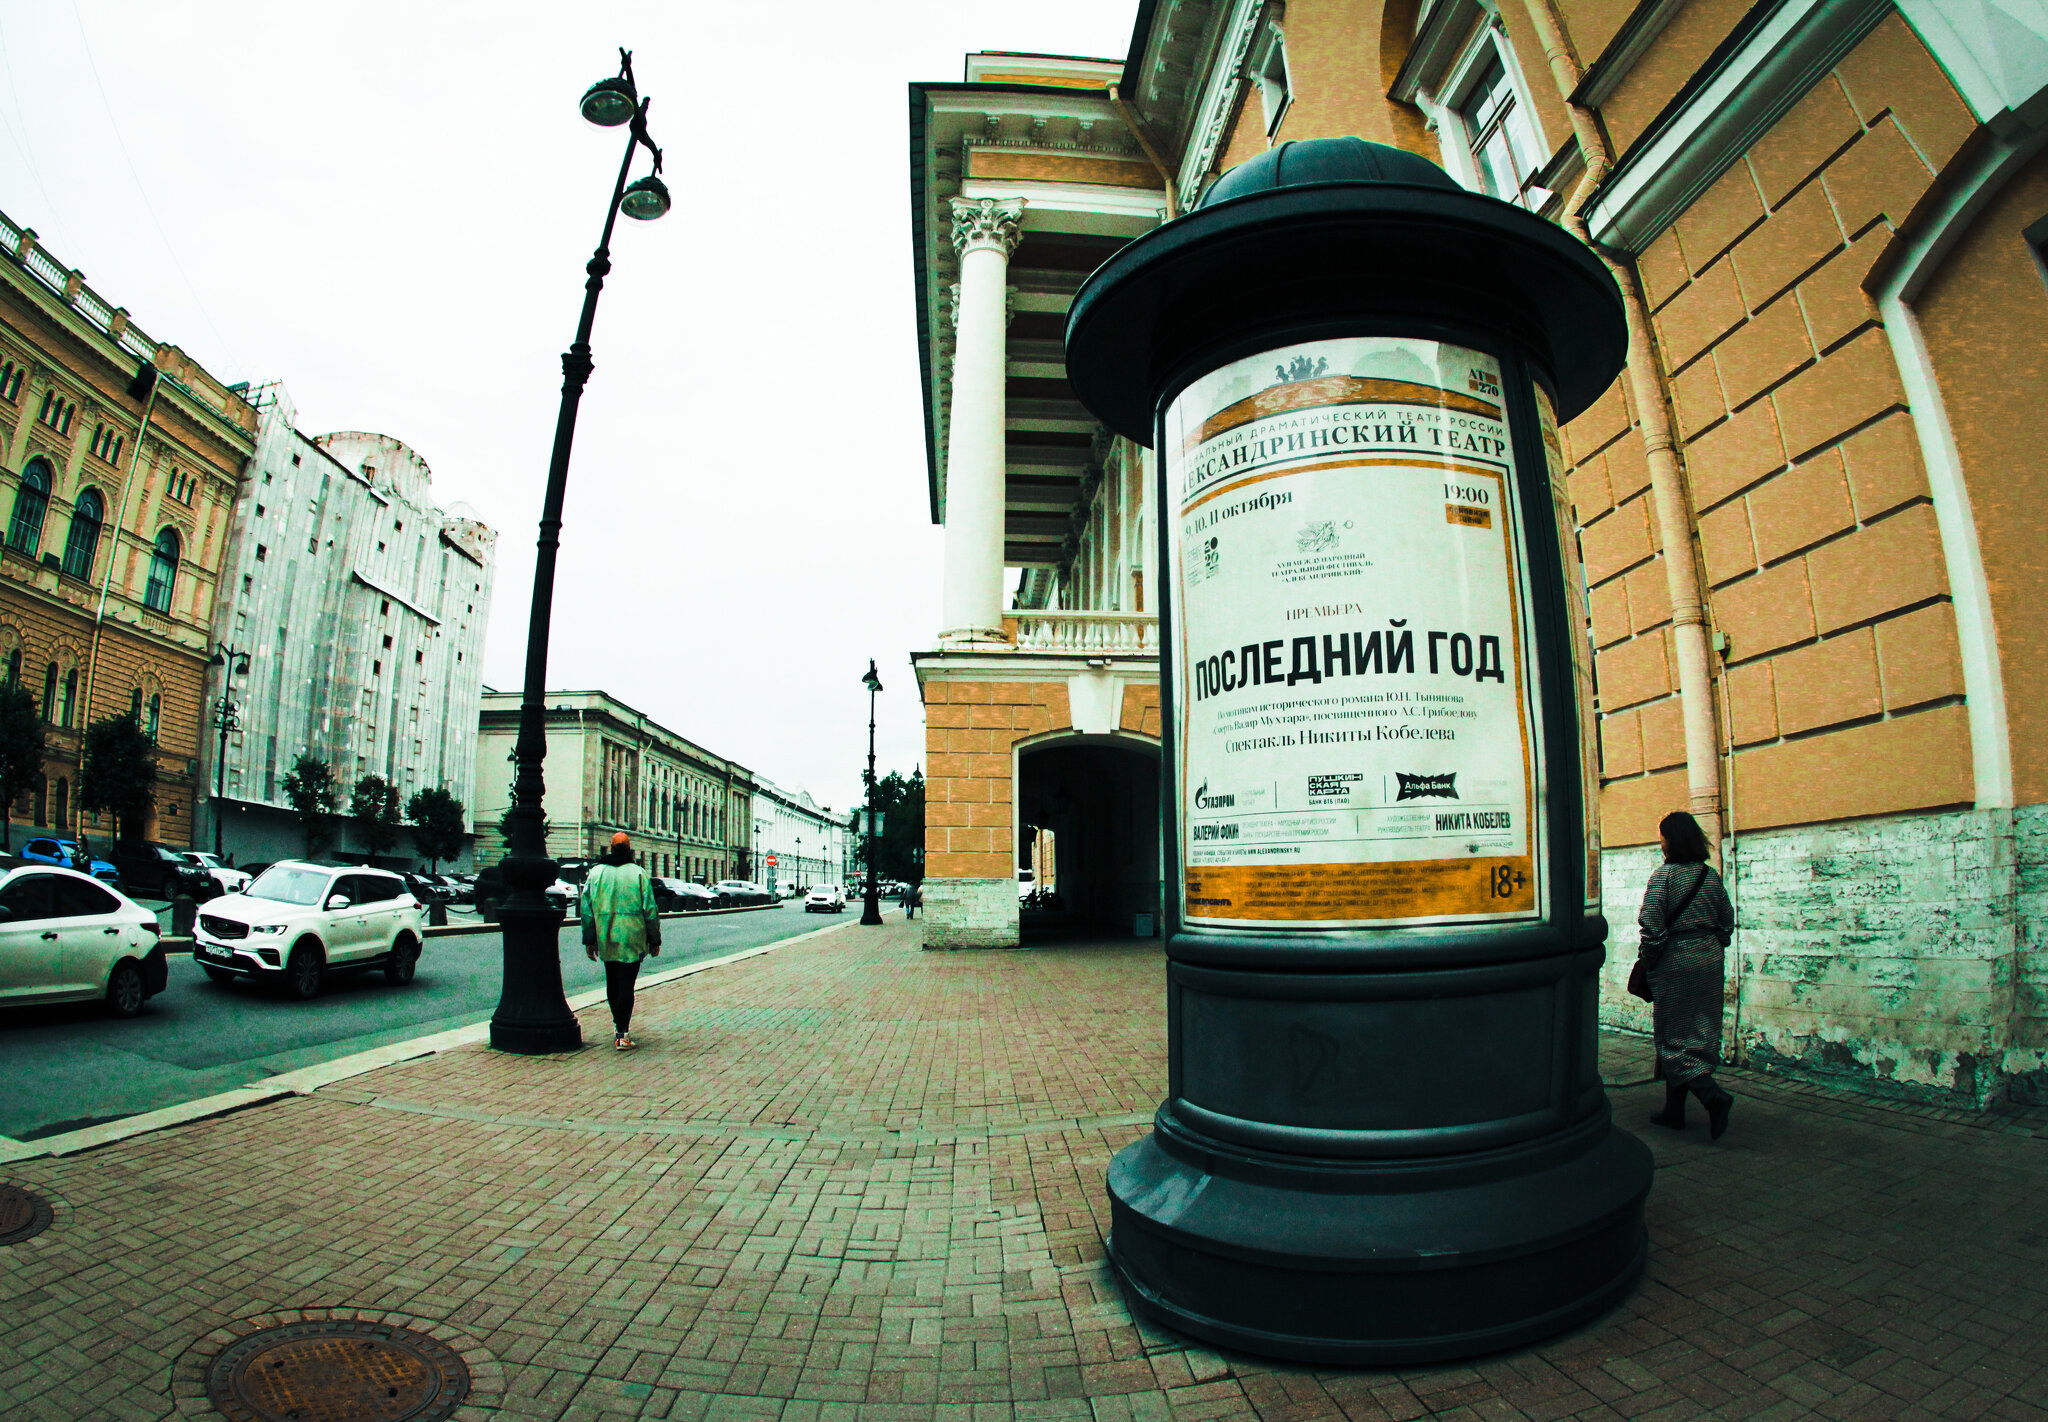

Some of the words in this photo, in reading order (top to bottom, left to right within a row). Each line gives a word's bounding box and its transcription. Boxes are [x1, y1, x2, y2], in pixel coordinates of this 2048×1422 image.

[1478, 382, 1499, 397] 270
[1250, 409, 1387, 440] ДРАМАТИЧЕСКИЙ
[1397, 411, 1441, 423] ТЕАТР
[1450, 417, 1503, 436] РОССИИ
[1428, 427, 1506, 457] ТЕАТР
[1443, 484, 1489, 504] 19:00
[1210, 509, 1218, 525] 11
[1222, 492, 1293, 520] октября
[1271, 564, 1325, 578] ТЕАТРАЛЬНЫЙ
[1326, 560, 1374, 570] ФЕСТИВАЛЬ
[1286, 603, 1362, 620] ПРЕМЬЕРА
[1195, 619, 1415, 701] ПОСЛЕДНИЙ
[1428, 631, 1505, 683] ГОД
[1259, 696, 1339, 712] исторического
[1341, 694, 1384, 706] романа
[1386, 692, 1411, 702] Ю.Н.
[1416, 692, 1464, 703] Тынянова
[1313, 707, 1398, 721] посвященного
[1422, 706, 1477, 720] Грибоедову
[1225, 735, 1296, 754] Спектакль
[1299, 729, 1371, 745] Никиты
[1376, 724, 1455, 741] Кобелева
[1308, 774, 1362, 783] ПУШКИН
[1404, 781, 1431, 793] Альфа
[1431, 781, 1452, 790] Банк
[1207, 794, 1235, 809] ГАЗПРОМ
[1308, 788, 1350, 796] КАРТА
[1193, 820, 1220, 841] ВАЛЕРИЙ
[1220, 823, 1240, 840] ФОКИН
[1435, 812, 1472, 831] НИКИТА
[1473, 811, 1511, 829] КОБЕЛЕВ
[1490, 864, 1527, 899] 18+
